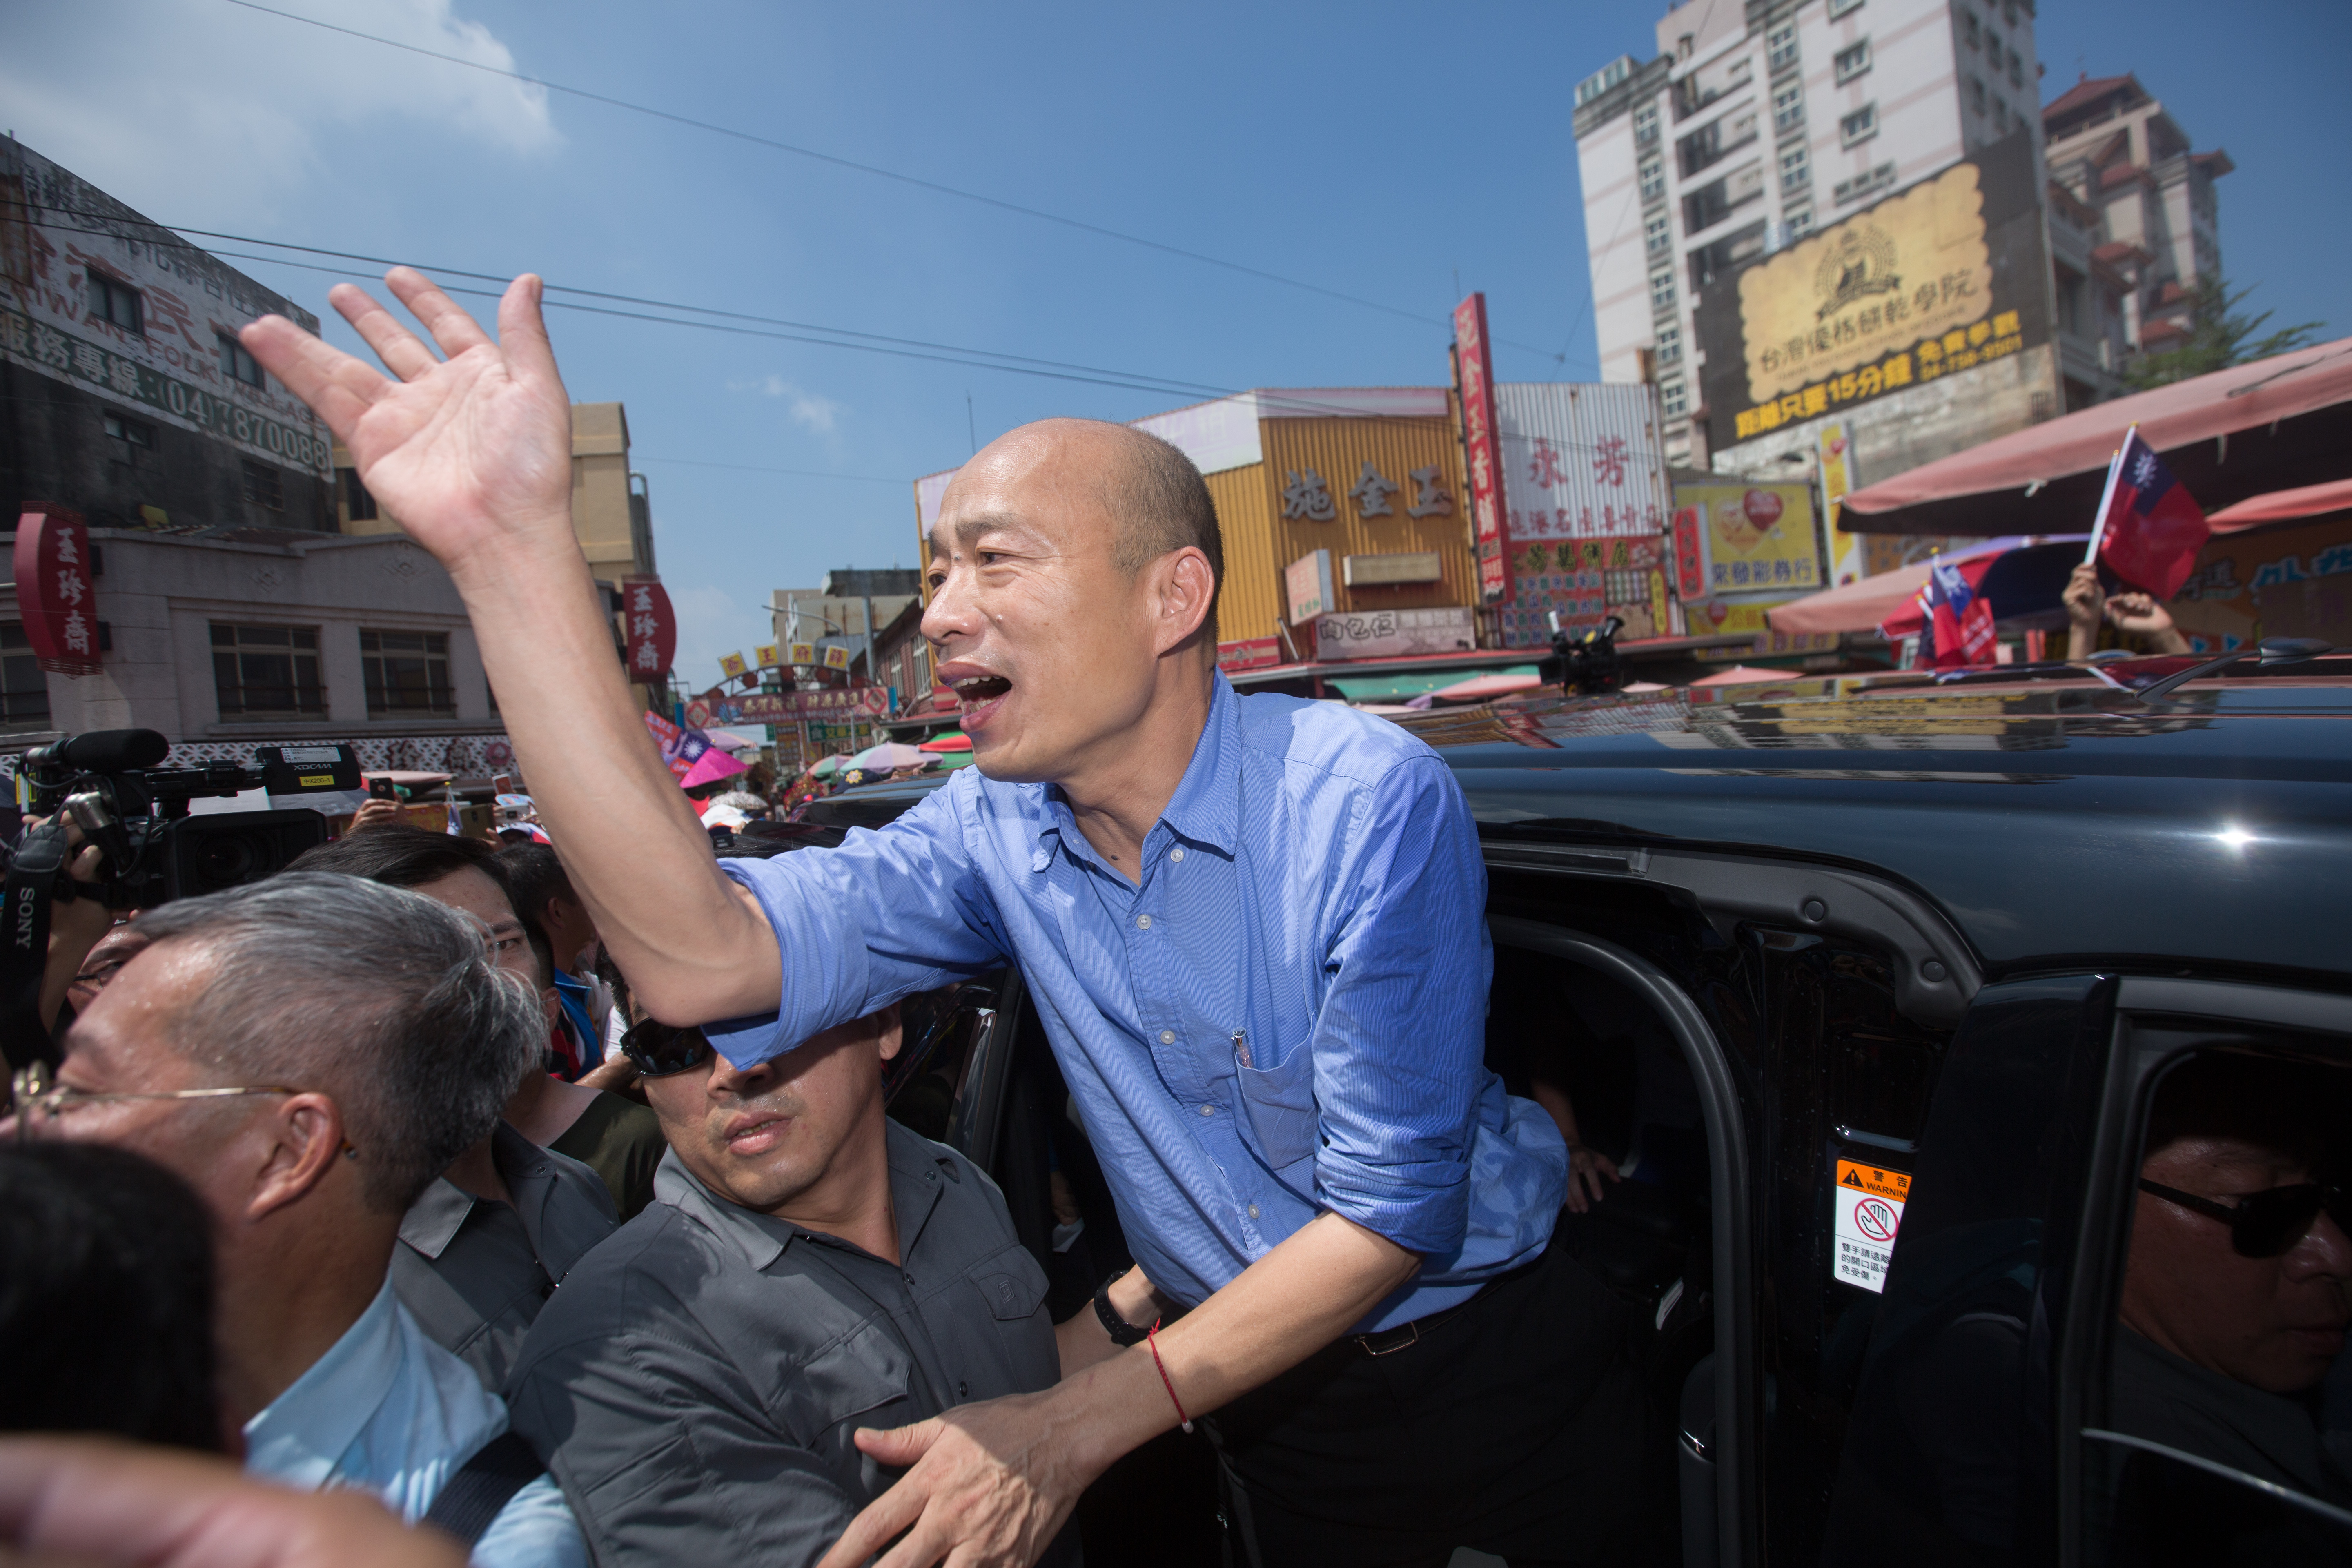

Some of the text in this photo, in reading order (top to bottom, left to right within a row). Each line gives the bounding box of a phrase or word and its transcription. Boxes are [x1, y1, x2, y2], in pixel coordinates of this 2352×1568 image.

[1761, 268, 1978, 374] 台灣優格餅乾學院
[1917, 310, 2021, 363] 免費參觀
[145, 337, 218, 385] FOLK
[158, 379, 329, 470] (04)7870088
[1735, 354, 1913, 439] 距離只要15分鐘
[1282, 461, 1454, 522] 施金玉
[56, 527, 91, 656] 玉珍齋
[633, 585, 660, 671] 玉珍齋
[743, 691, 861, 714] 恭賀新禧 財源廣進
[15, 887, 36, 950] SONY
[1866, 1181, 1907, 1199] WARNIN
